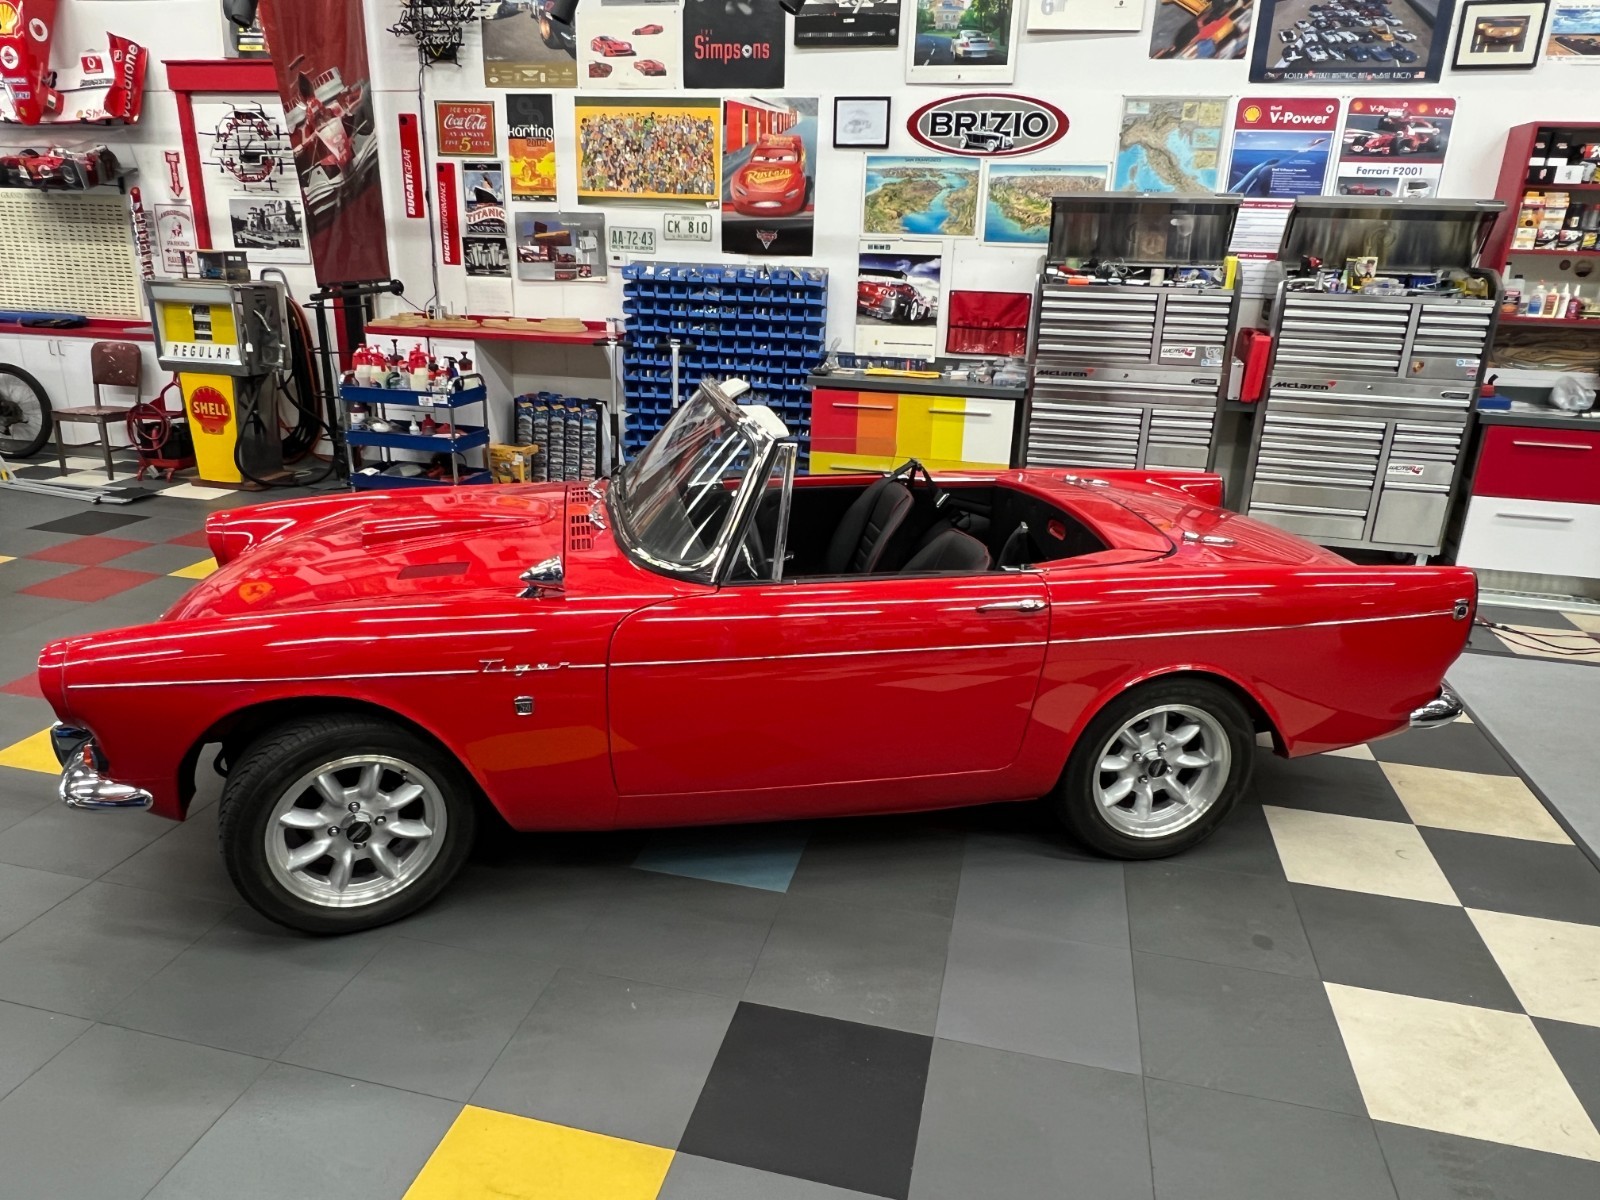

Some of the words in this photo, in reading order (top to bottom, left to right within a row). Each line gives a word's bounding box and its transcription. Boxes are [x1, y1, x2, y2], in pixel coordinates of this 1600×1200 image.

[694, 34, 770, 65] Simpsons
[929, 111, 1050, 138] BRIZIO
[1269, 111, 1330, 124] V-Power
[507, 124, 554, 143] karting
[459, 137, 471, 152] 5
[1356, 166, 1390, 175] Ferrari
[1392, 166, 1423, 176] F2001
[465, 207, 506, 223] TITANIC
[667, 220, 681, 233] CK
[687, 221, 708, 234] 810
[173, 344, 231, 360] REGULAR
[1036, 369, 1088, 378] McLaren
[1272, 381, 1329, 390] McLaren
[193, 401, 229, 417] SHELL
